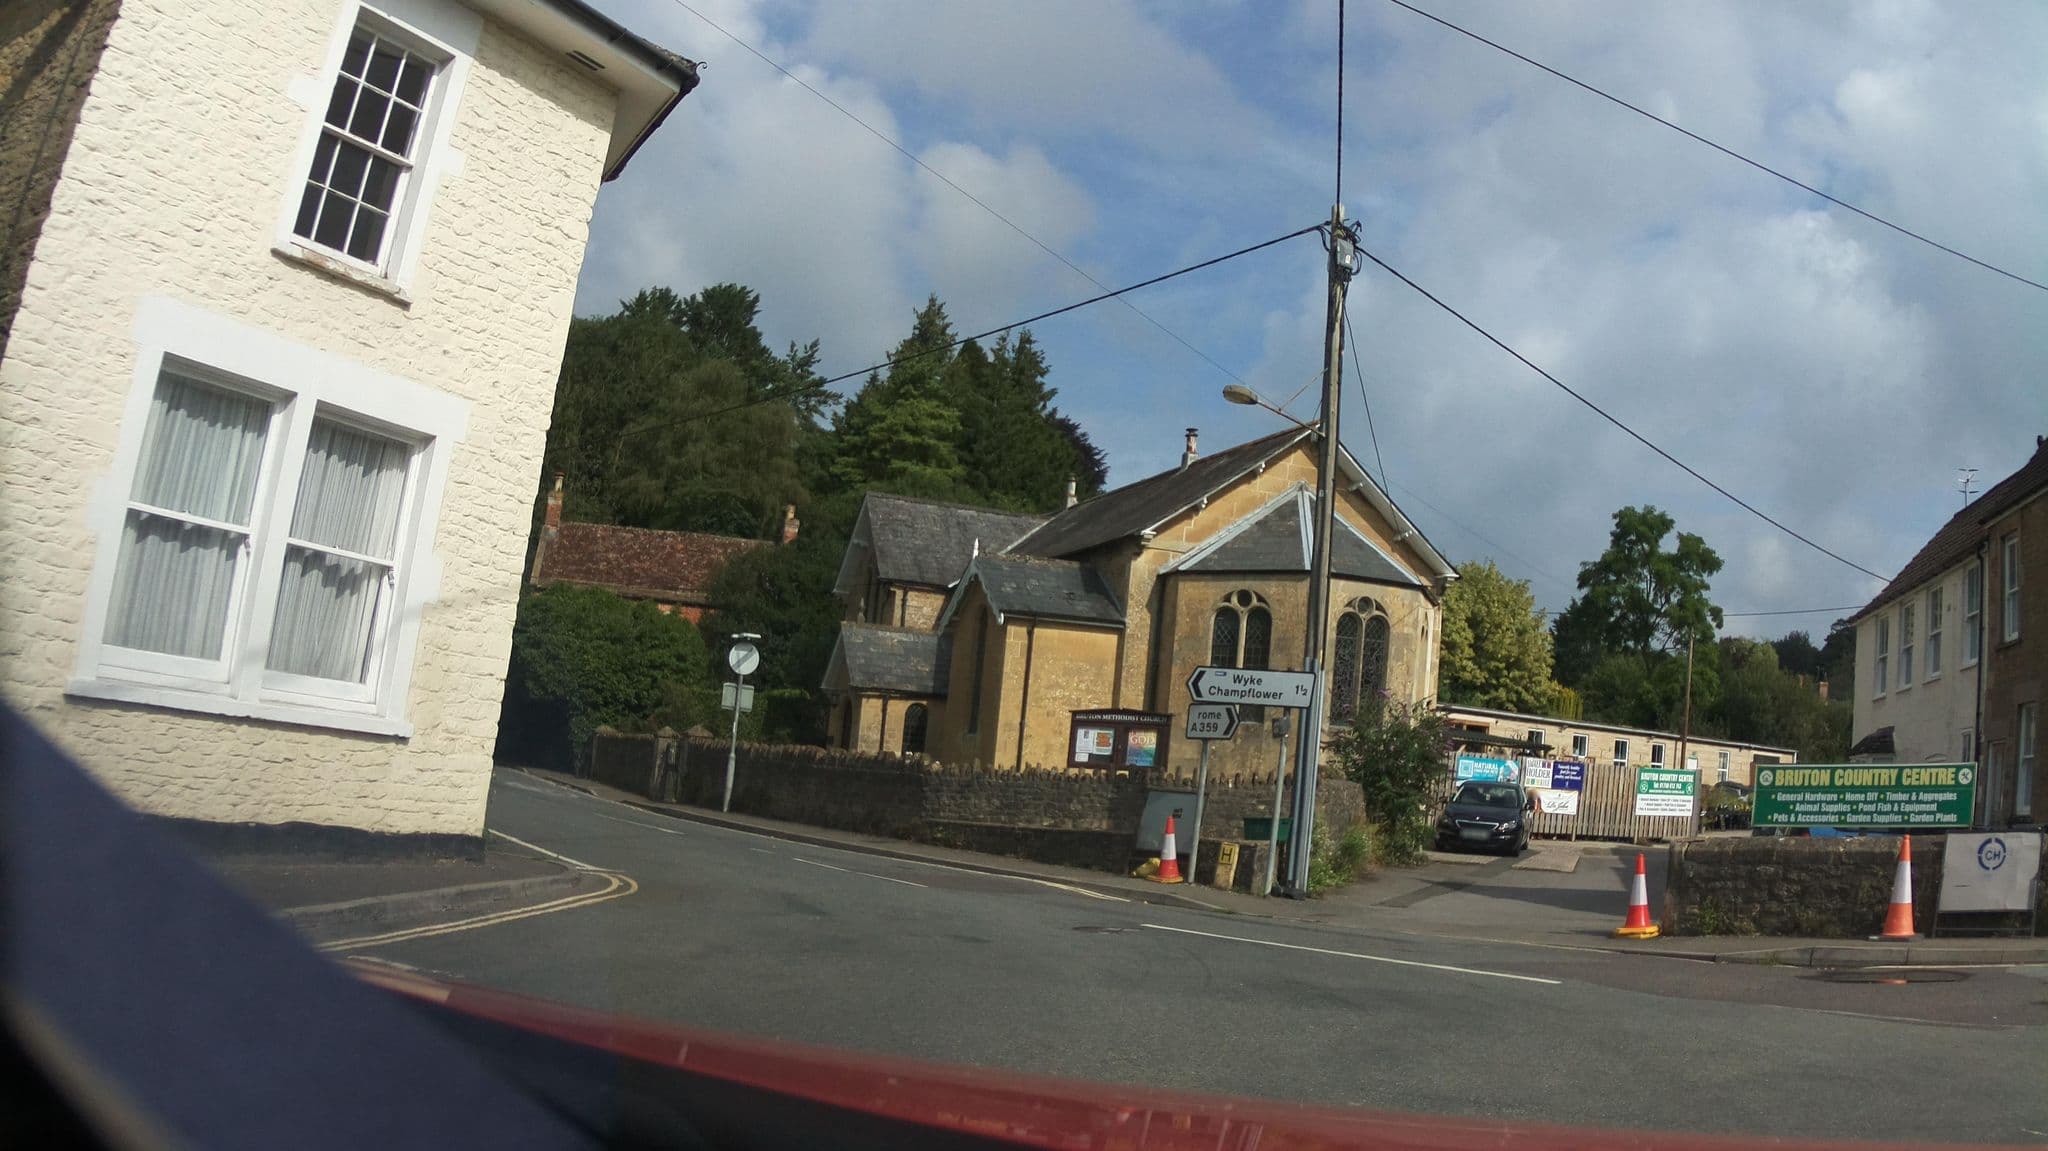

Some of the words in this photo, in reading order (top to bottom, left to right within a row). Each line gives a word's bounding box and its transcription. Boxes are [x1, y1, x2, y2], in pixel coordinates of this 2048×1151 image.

[1232, 674, 1263, 687] Wyke
[1208, 685, 1284, 700] Champflower
[1102, 713, 1139, 722] METHODIST
[1140, 714, 1168, 724] CHURCH
[1130, 735, 1156, 745] GOD
[1775, 769, 1831, 786] BRUTON
[1834, 768, 1899, 786] COUNTRY
[1902, 767, 1957, 786] CENTRE
[1776, 792, 1804, 801] General
[1804, 792, 1838, 801] Hardware
[1845, 792, 1866, 801] Home
[1866, 792, 1879, 801] DIY
[1885, 792, 1910, 801] Timber
[1911, 792, 1917, 801] &
[1918, 792, 1958, 802] Aggregates
[1794, 803, 1820, 812] Animal
[1820, 803, 1851, 813] Supplies
[1858, 803, 1876, 812] Pond
[1877, 803, 1892, 812] Fish
[1893, 803, 1899, 812] &
[1900, 803, 1938, 812] Equipment
[1772, 813, 1789, 822] Pets
[1790, 813, 1796, 822] &
[1796, 813, 1839, 823] Accessories
[1846, 814, 1872, 823] Garden
[1872, 814, 1902, 823] Supplies
[1909, 813, 1934, 823] Garden
[1935, 813, 1958, 823] Plants
[1222, 847, 1233, 862] H
[1984, 850, 2001, 861] CH
